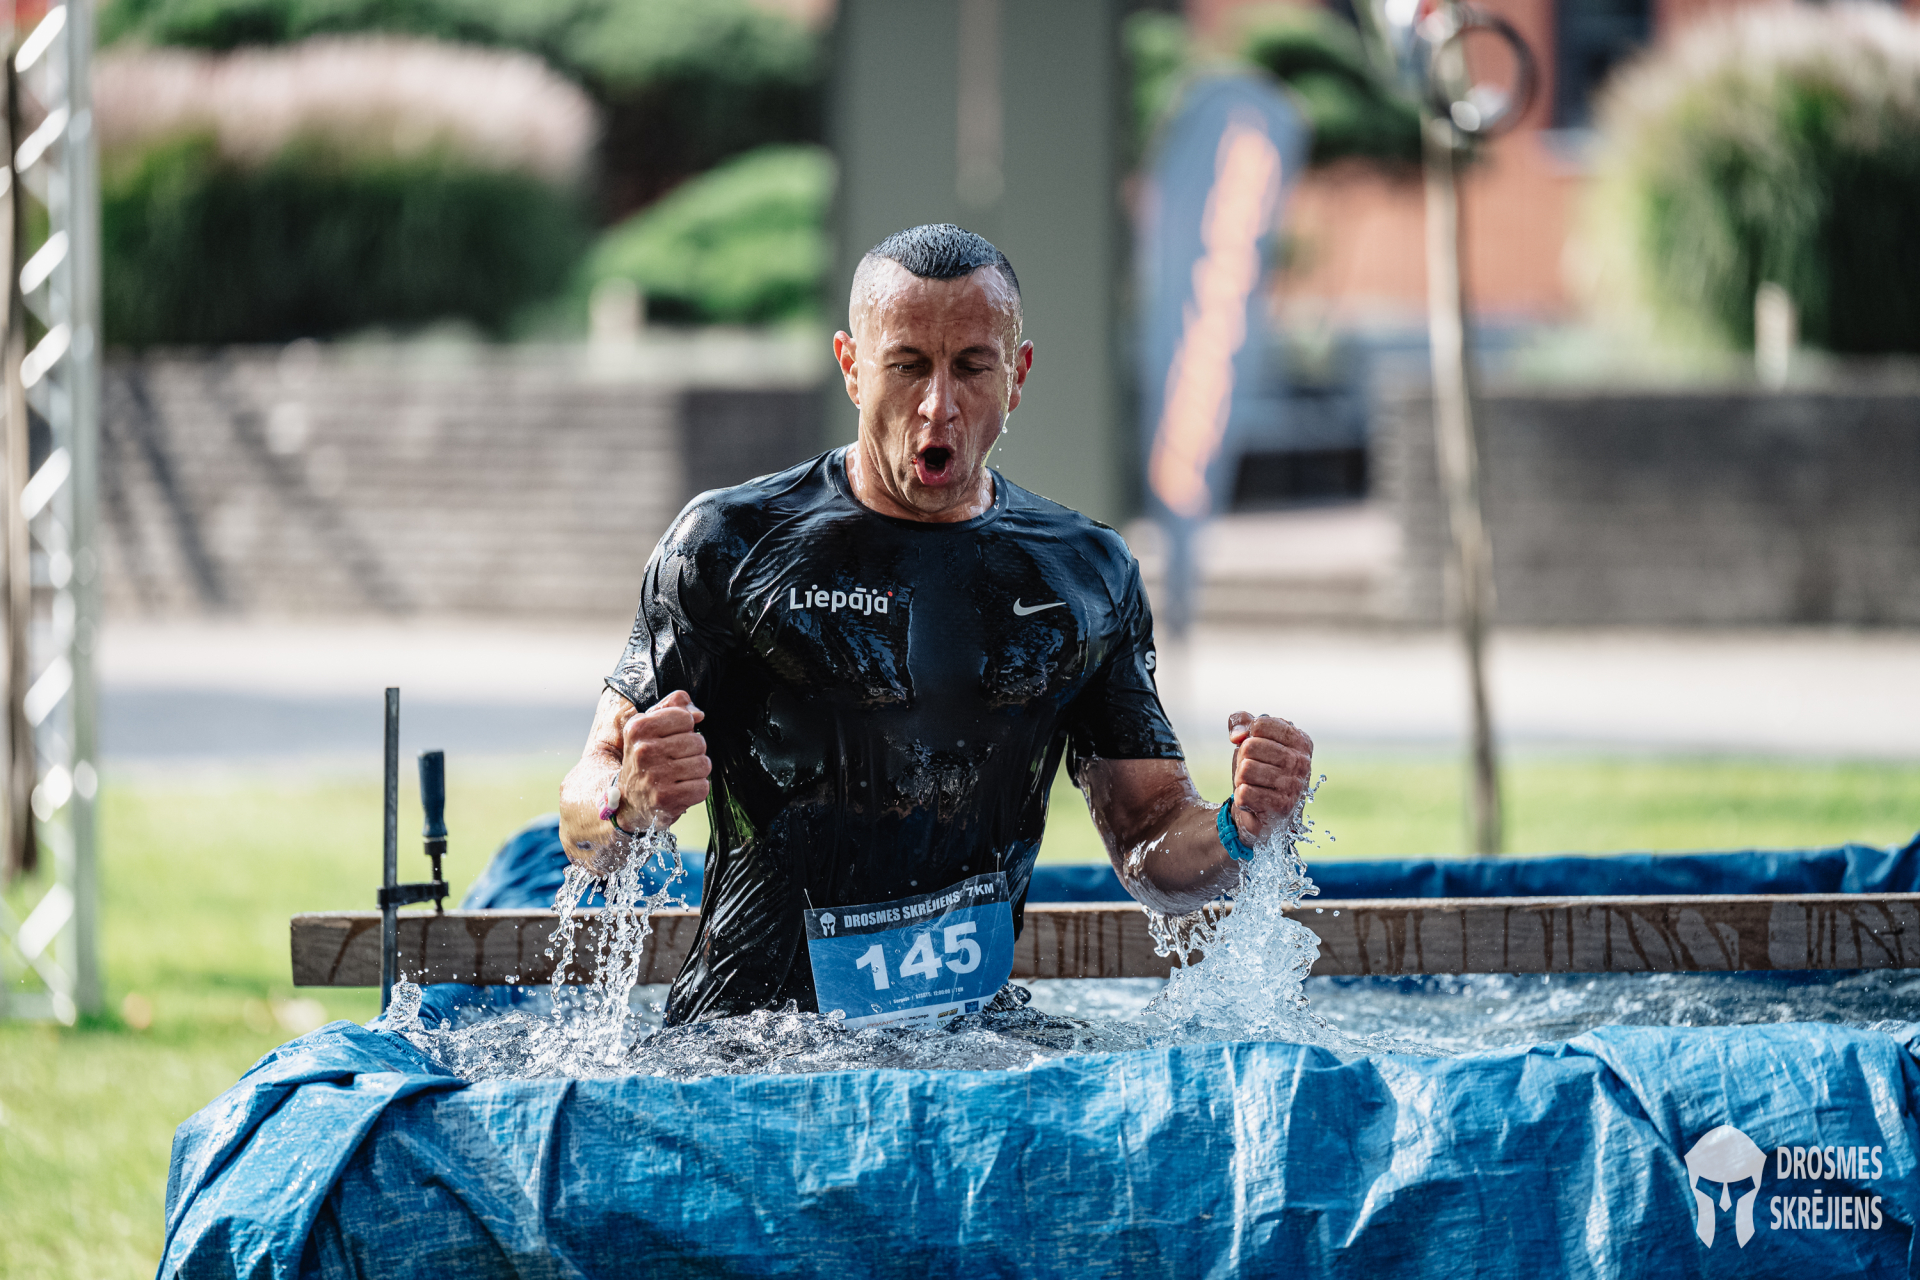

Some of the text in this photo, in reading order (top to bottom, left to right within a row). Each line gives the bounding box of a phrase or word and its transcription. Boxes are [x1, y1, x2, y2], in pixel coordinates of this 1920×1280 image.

[789, 584, 889, 616] Liepāja
[843, 907, 901, 928] DROSMES
[901, 890, 961, 919] SKRĒJIENS
[855, 921, 982, 991] 145
